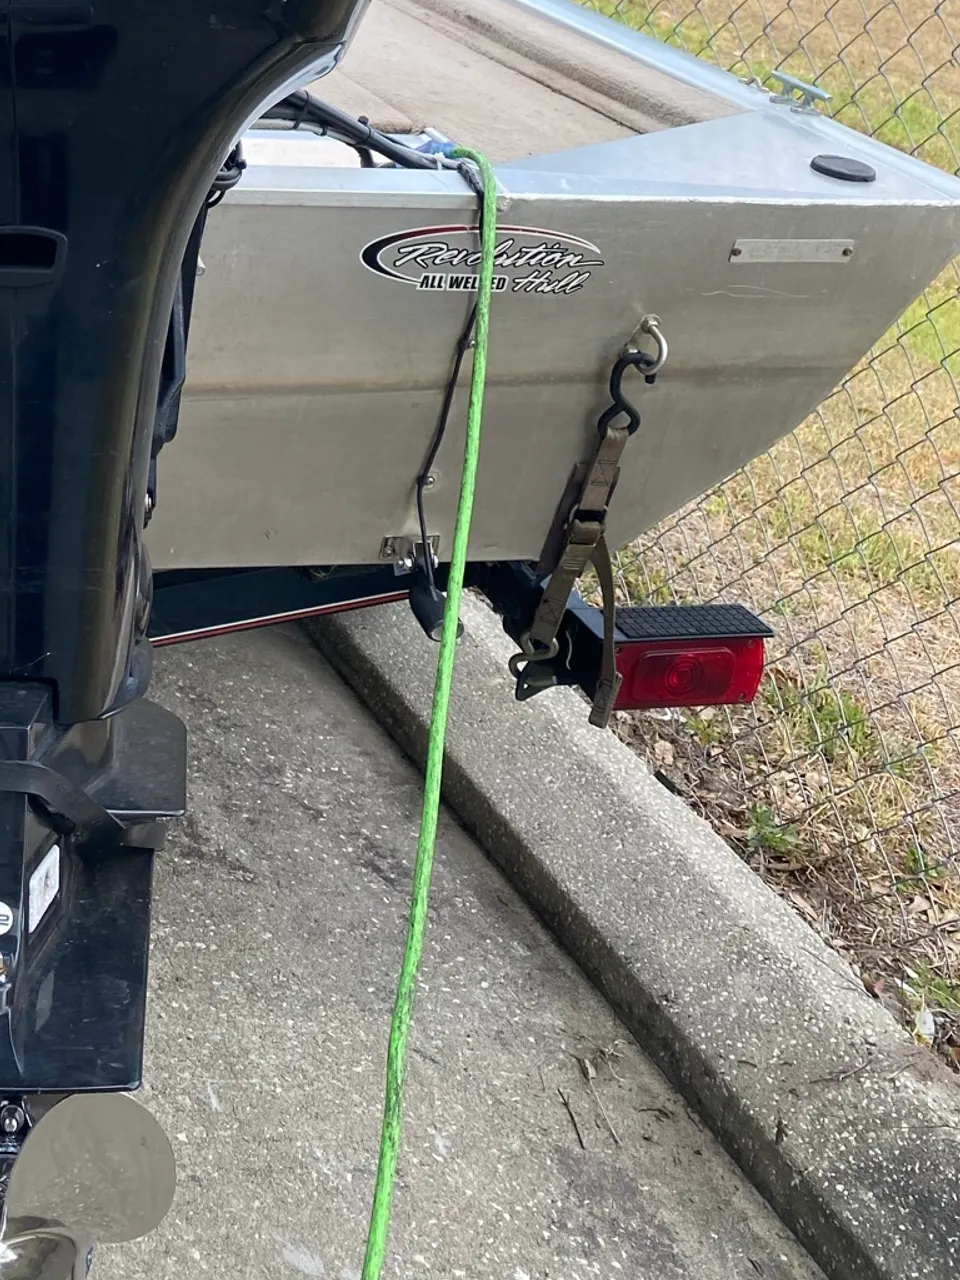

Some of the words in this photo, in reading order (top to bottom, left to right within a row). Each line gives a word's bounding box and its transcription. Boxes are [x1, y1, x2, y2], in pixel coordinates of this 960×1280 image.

[420, 274, 444, 289] ALL
[447, 275, 506, 290] WELED
[512, 270, 591, 294] Hull
